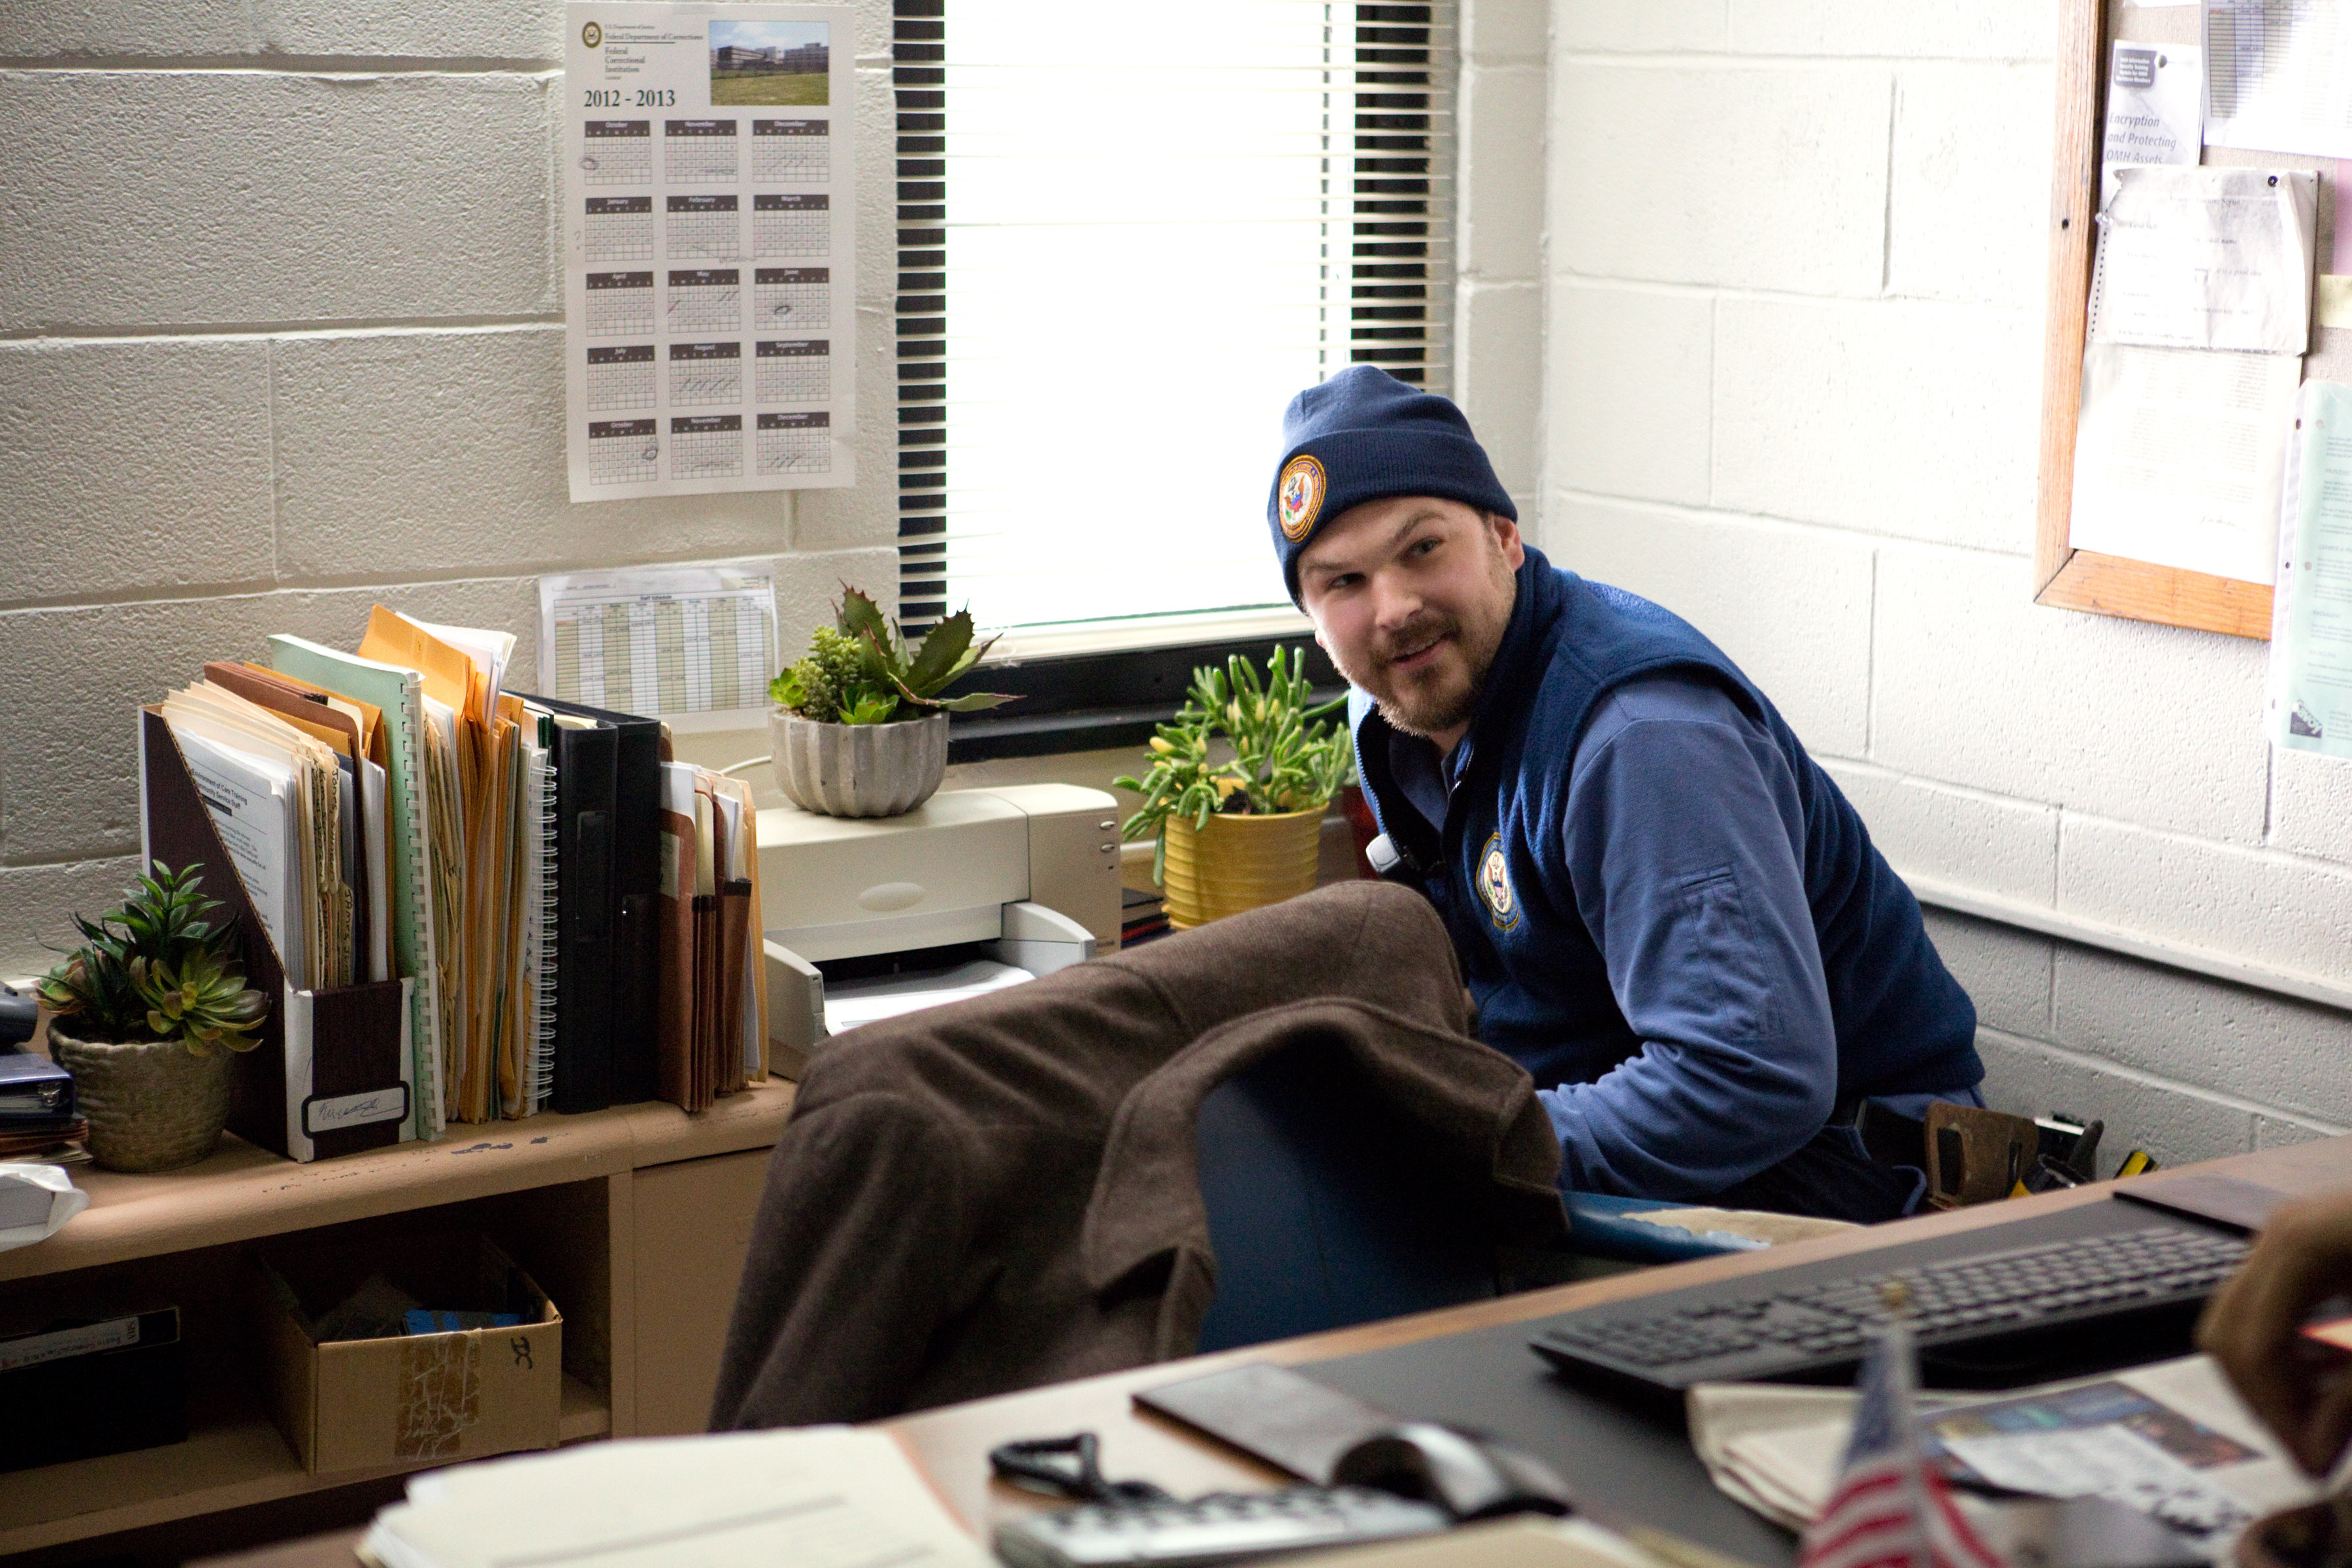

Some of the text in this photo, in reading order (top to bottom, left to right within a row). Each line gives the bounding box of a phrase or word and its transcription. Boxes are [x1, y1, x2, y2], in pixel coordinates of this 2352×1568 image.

[626, 33, 659, 42] Department
[604, 46, 629, 55] Federal
[604, 56, 645, 64] Correctional
[583, 90, 620, 107] 2012
[636, 89, 676, 107] 2013
[2109, 112, 2160, 129] Encryption
[2108, 132, 2177, 152] and Protecting
[2106, 150, 2163, 164] OMH Assets
[191, 768, 216, 787] Environment
[221, 784, 231, 795] Care
[231, 789, 248, 806] Training
[216, 791, 231, 804] Service
[231, 799, 240, 810] Staff
